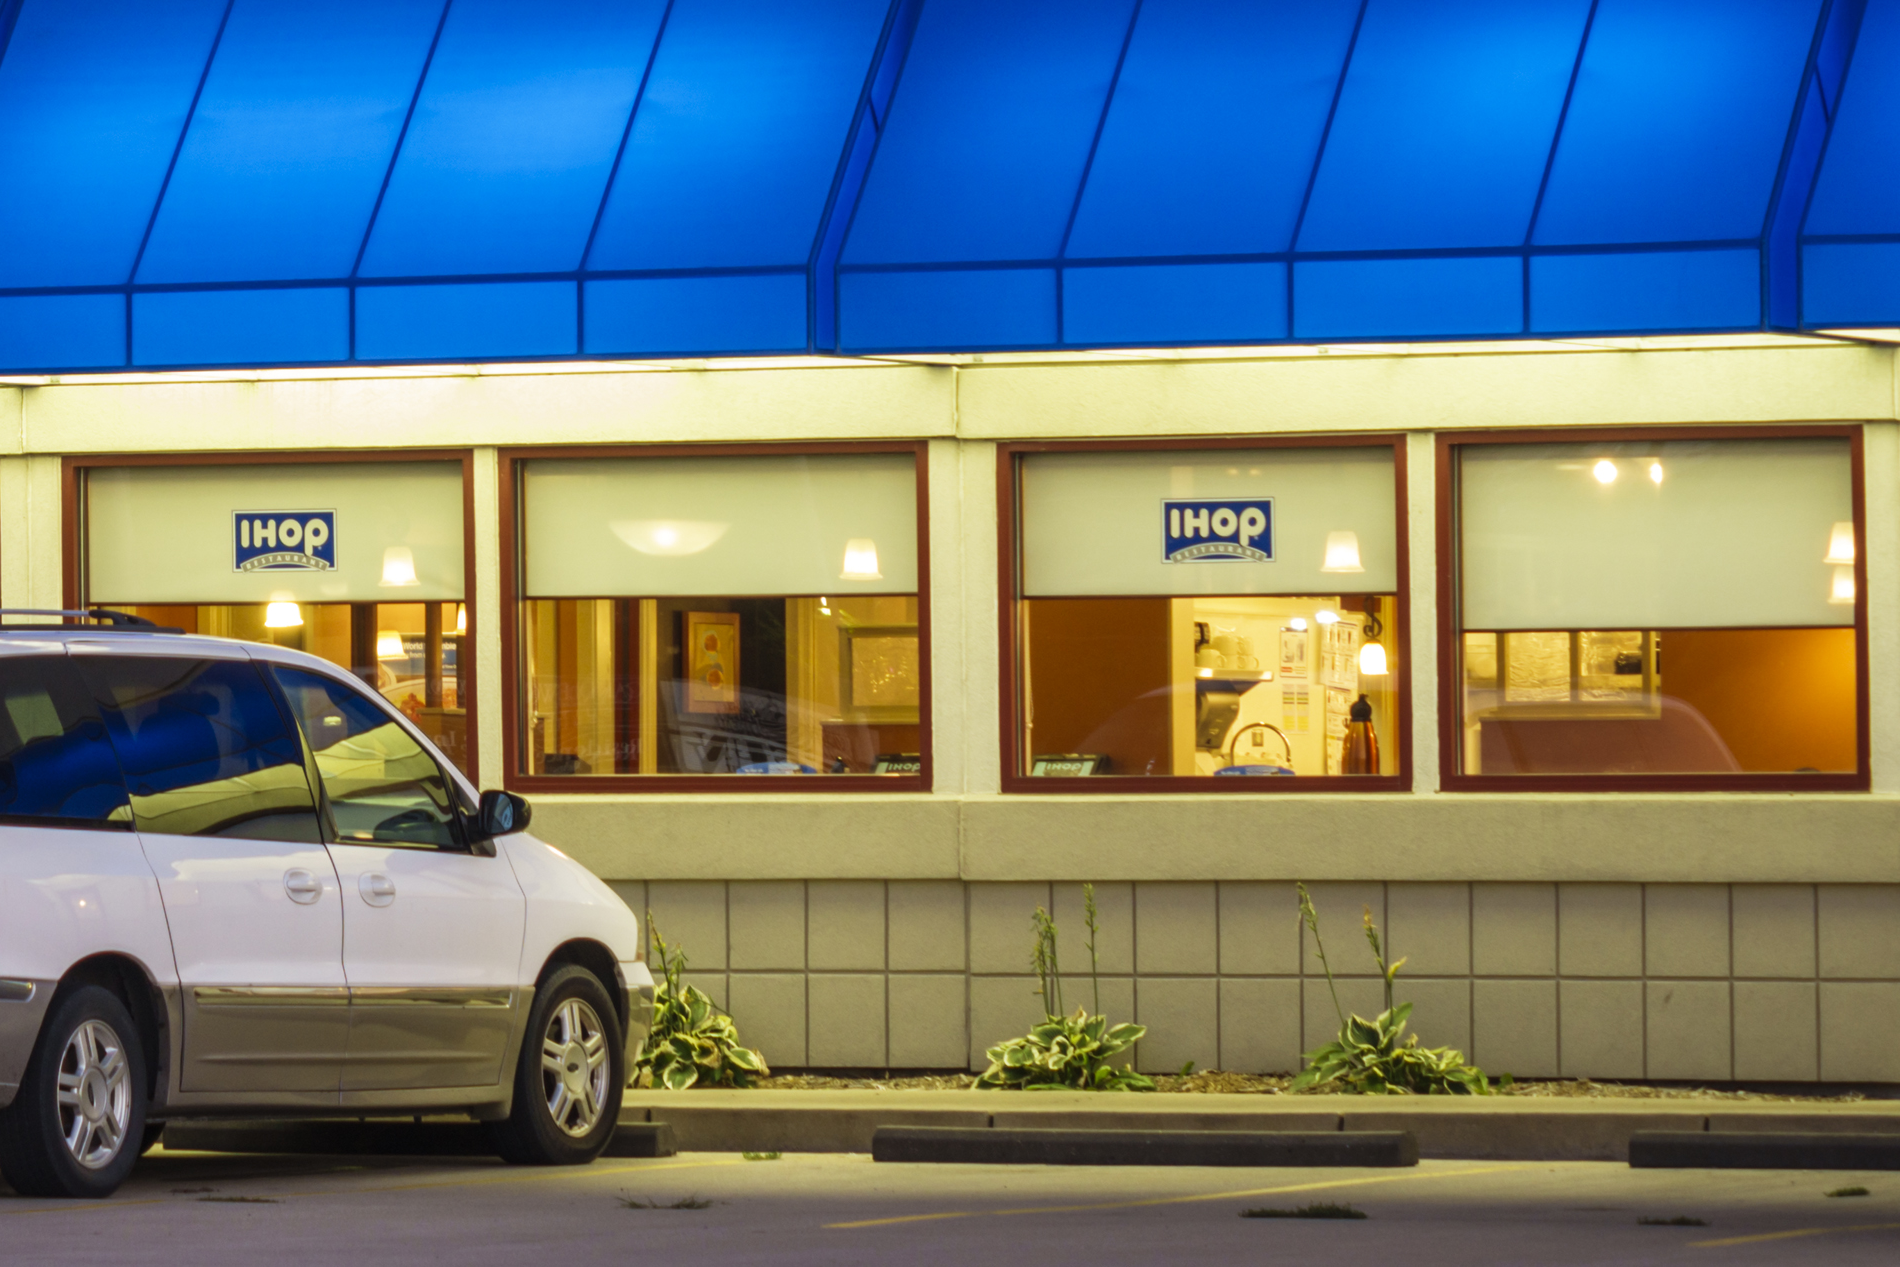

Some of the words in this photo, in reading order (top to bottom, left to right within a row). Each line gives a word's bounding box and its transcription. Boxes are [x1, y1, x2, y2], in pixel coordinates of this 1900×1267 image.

[241, 518, 329, 557] IHOP
[1170, 507, 1266, 547] IHOP
[246, 554, 324, 570] RESTAURANT
[1176, 545, 1261, 561] RESTAURANT
